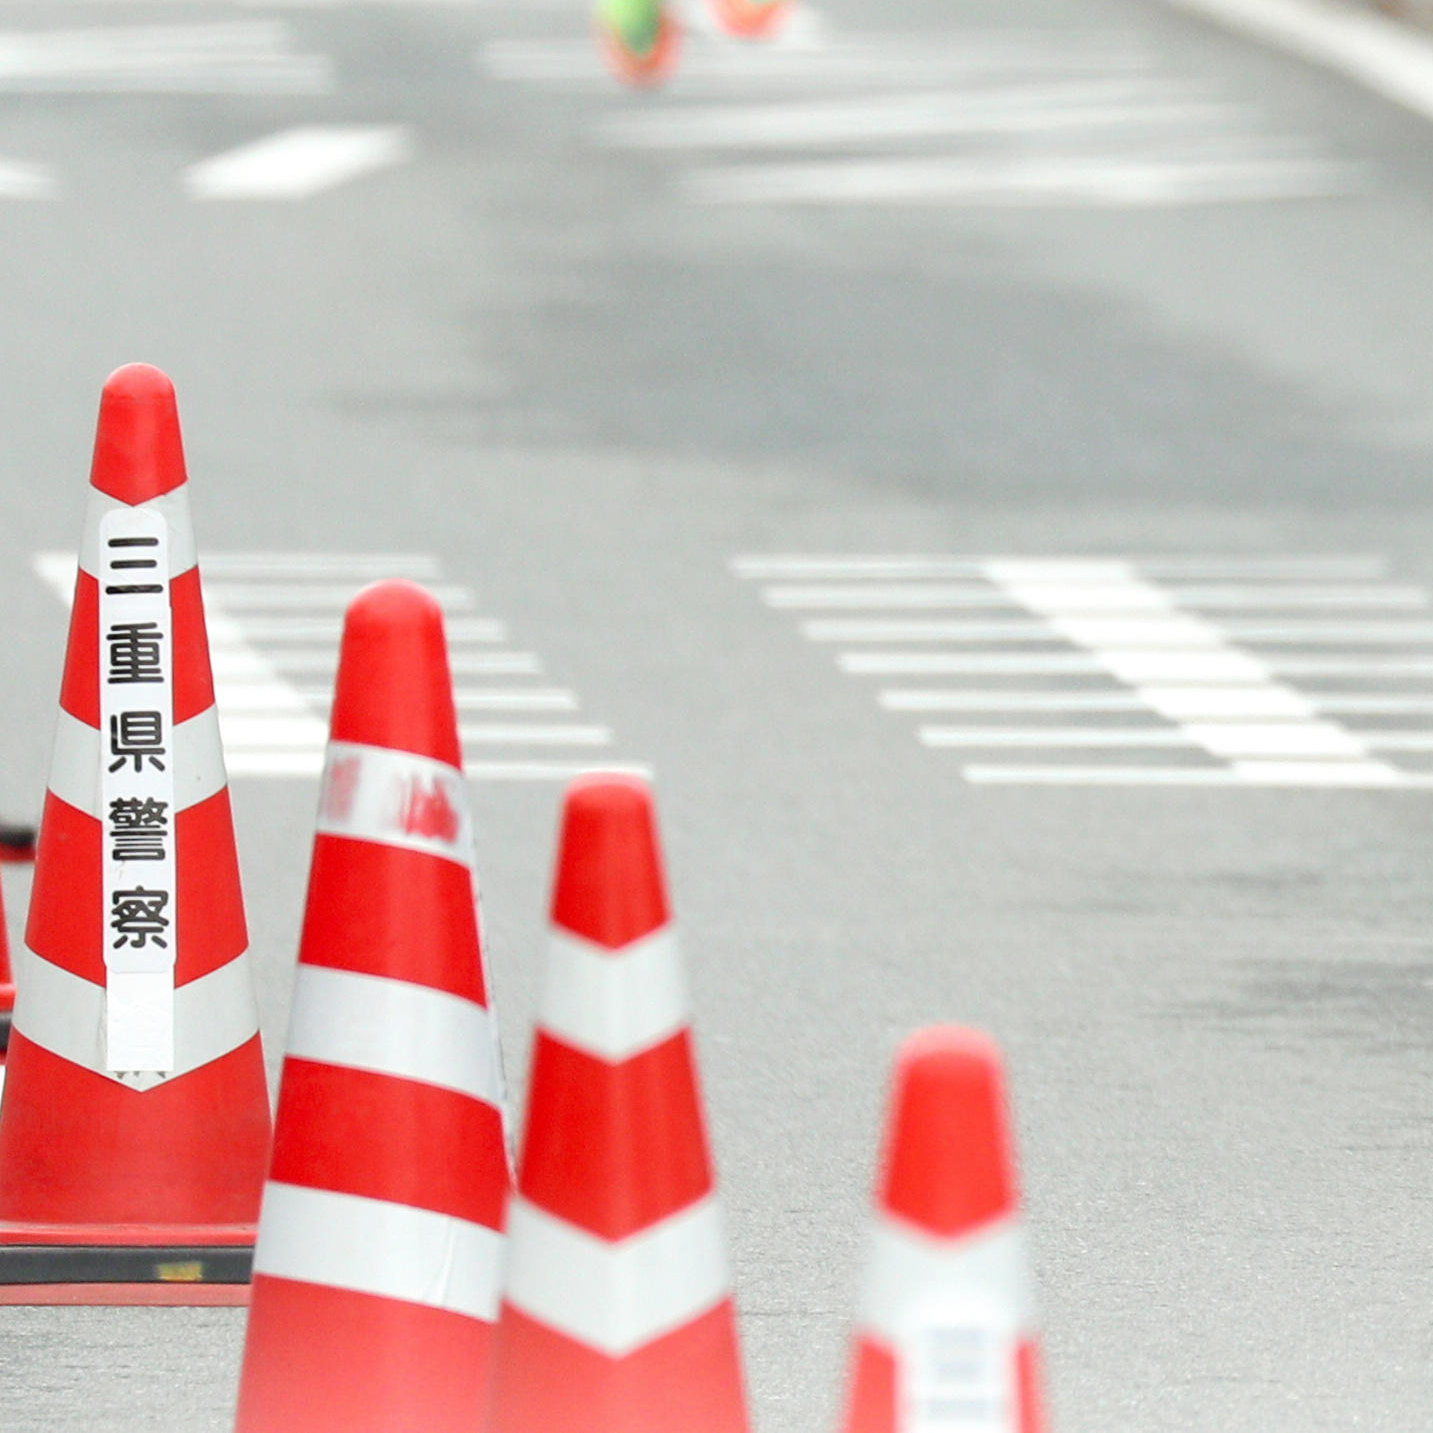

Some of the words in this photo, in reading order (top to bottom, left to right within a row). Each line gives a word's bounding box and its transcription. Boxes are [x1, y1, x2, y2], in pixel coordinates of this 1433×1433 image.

[105, 536, 170, 951] 三重県警察
